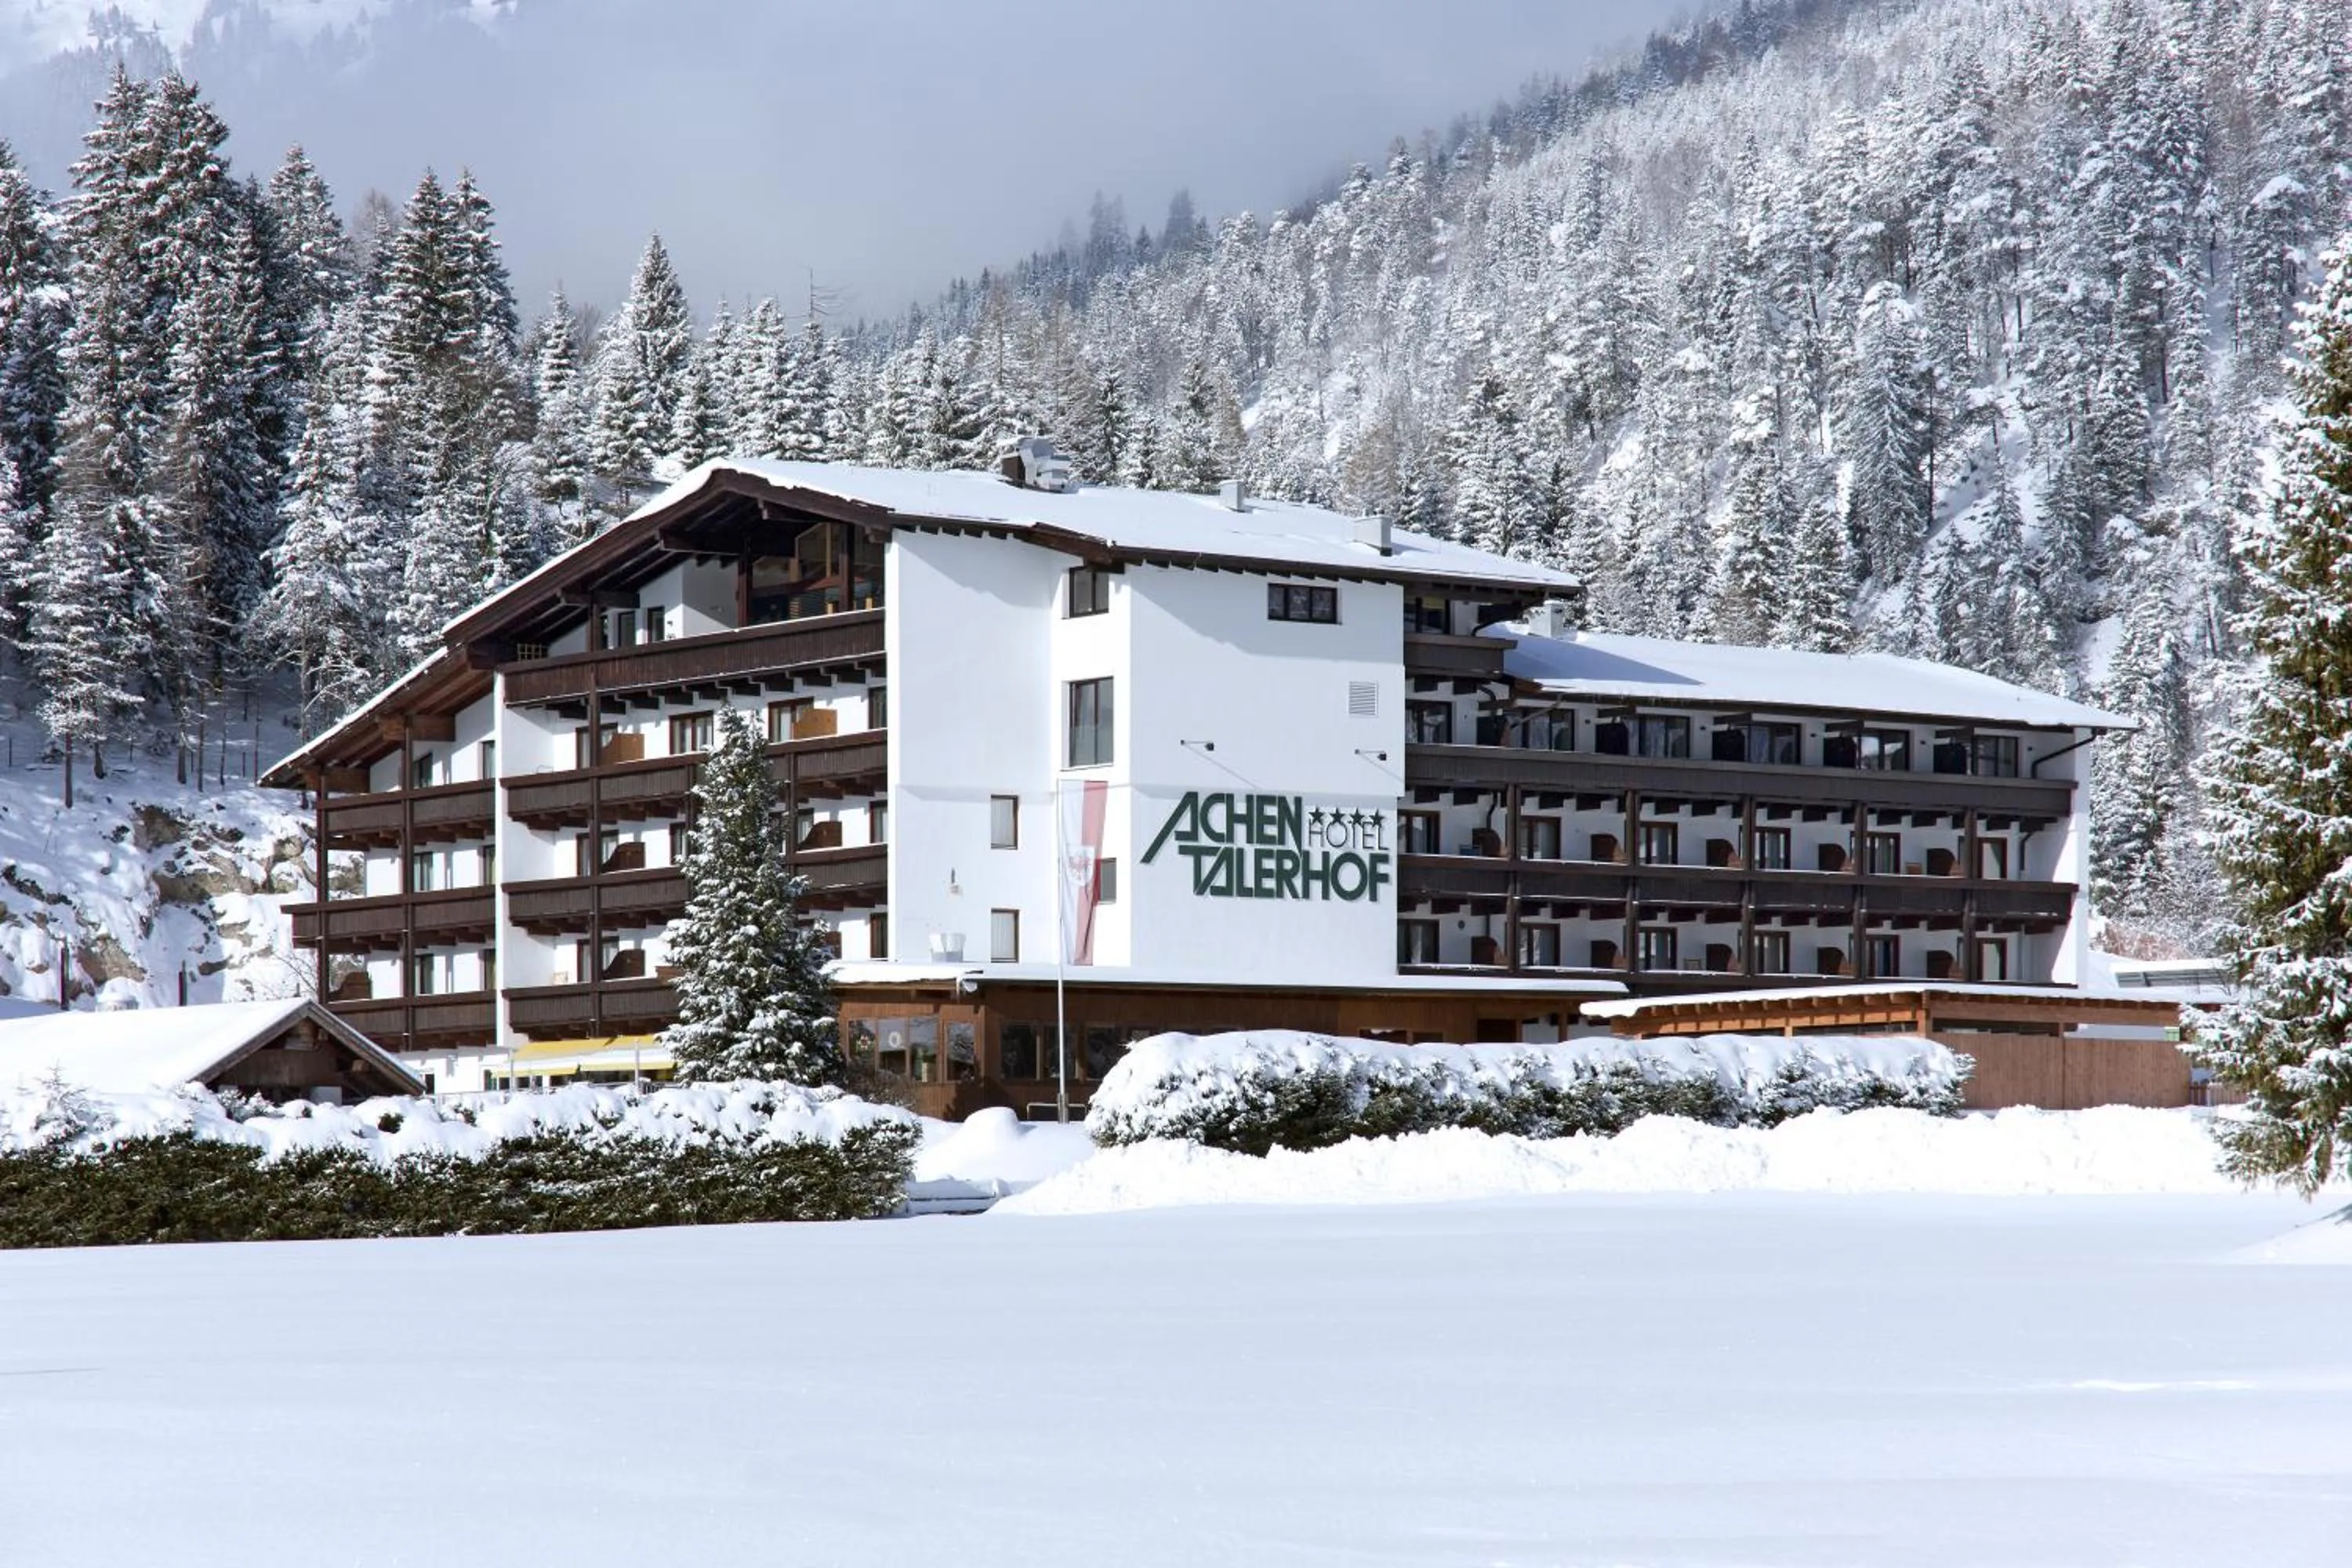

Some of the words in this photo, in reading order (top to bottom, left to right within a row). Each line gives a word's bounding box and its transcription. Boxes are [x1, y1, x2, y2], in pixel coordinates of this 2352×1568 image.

[1140, 791, 1302, 863] ACHEN
[1308, 818, 1389, 851] HOTEL
[1178, 844, 1389, 902] TALERHOF
